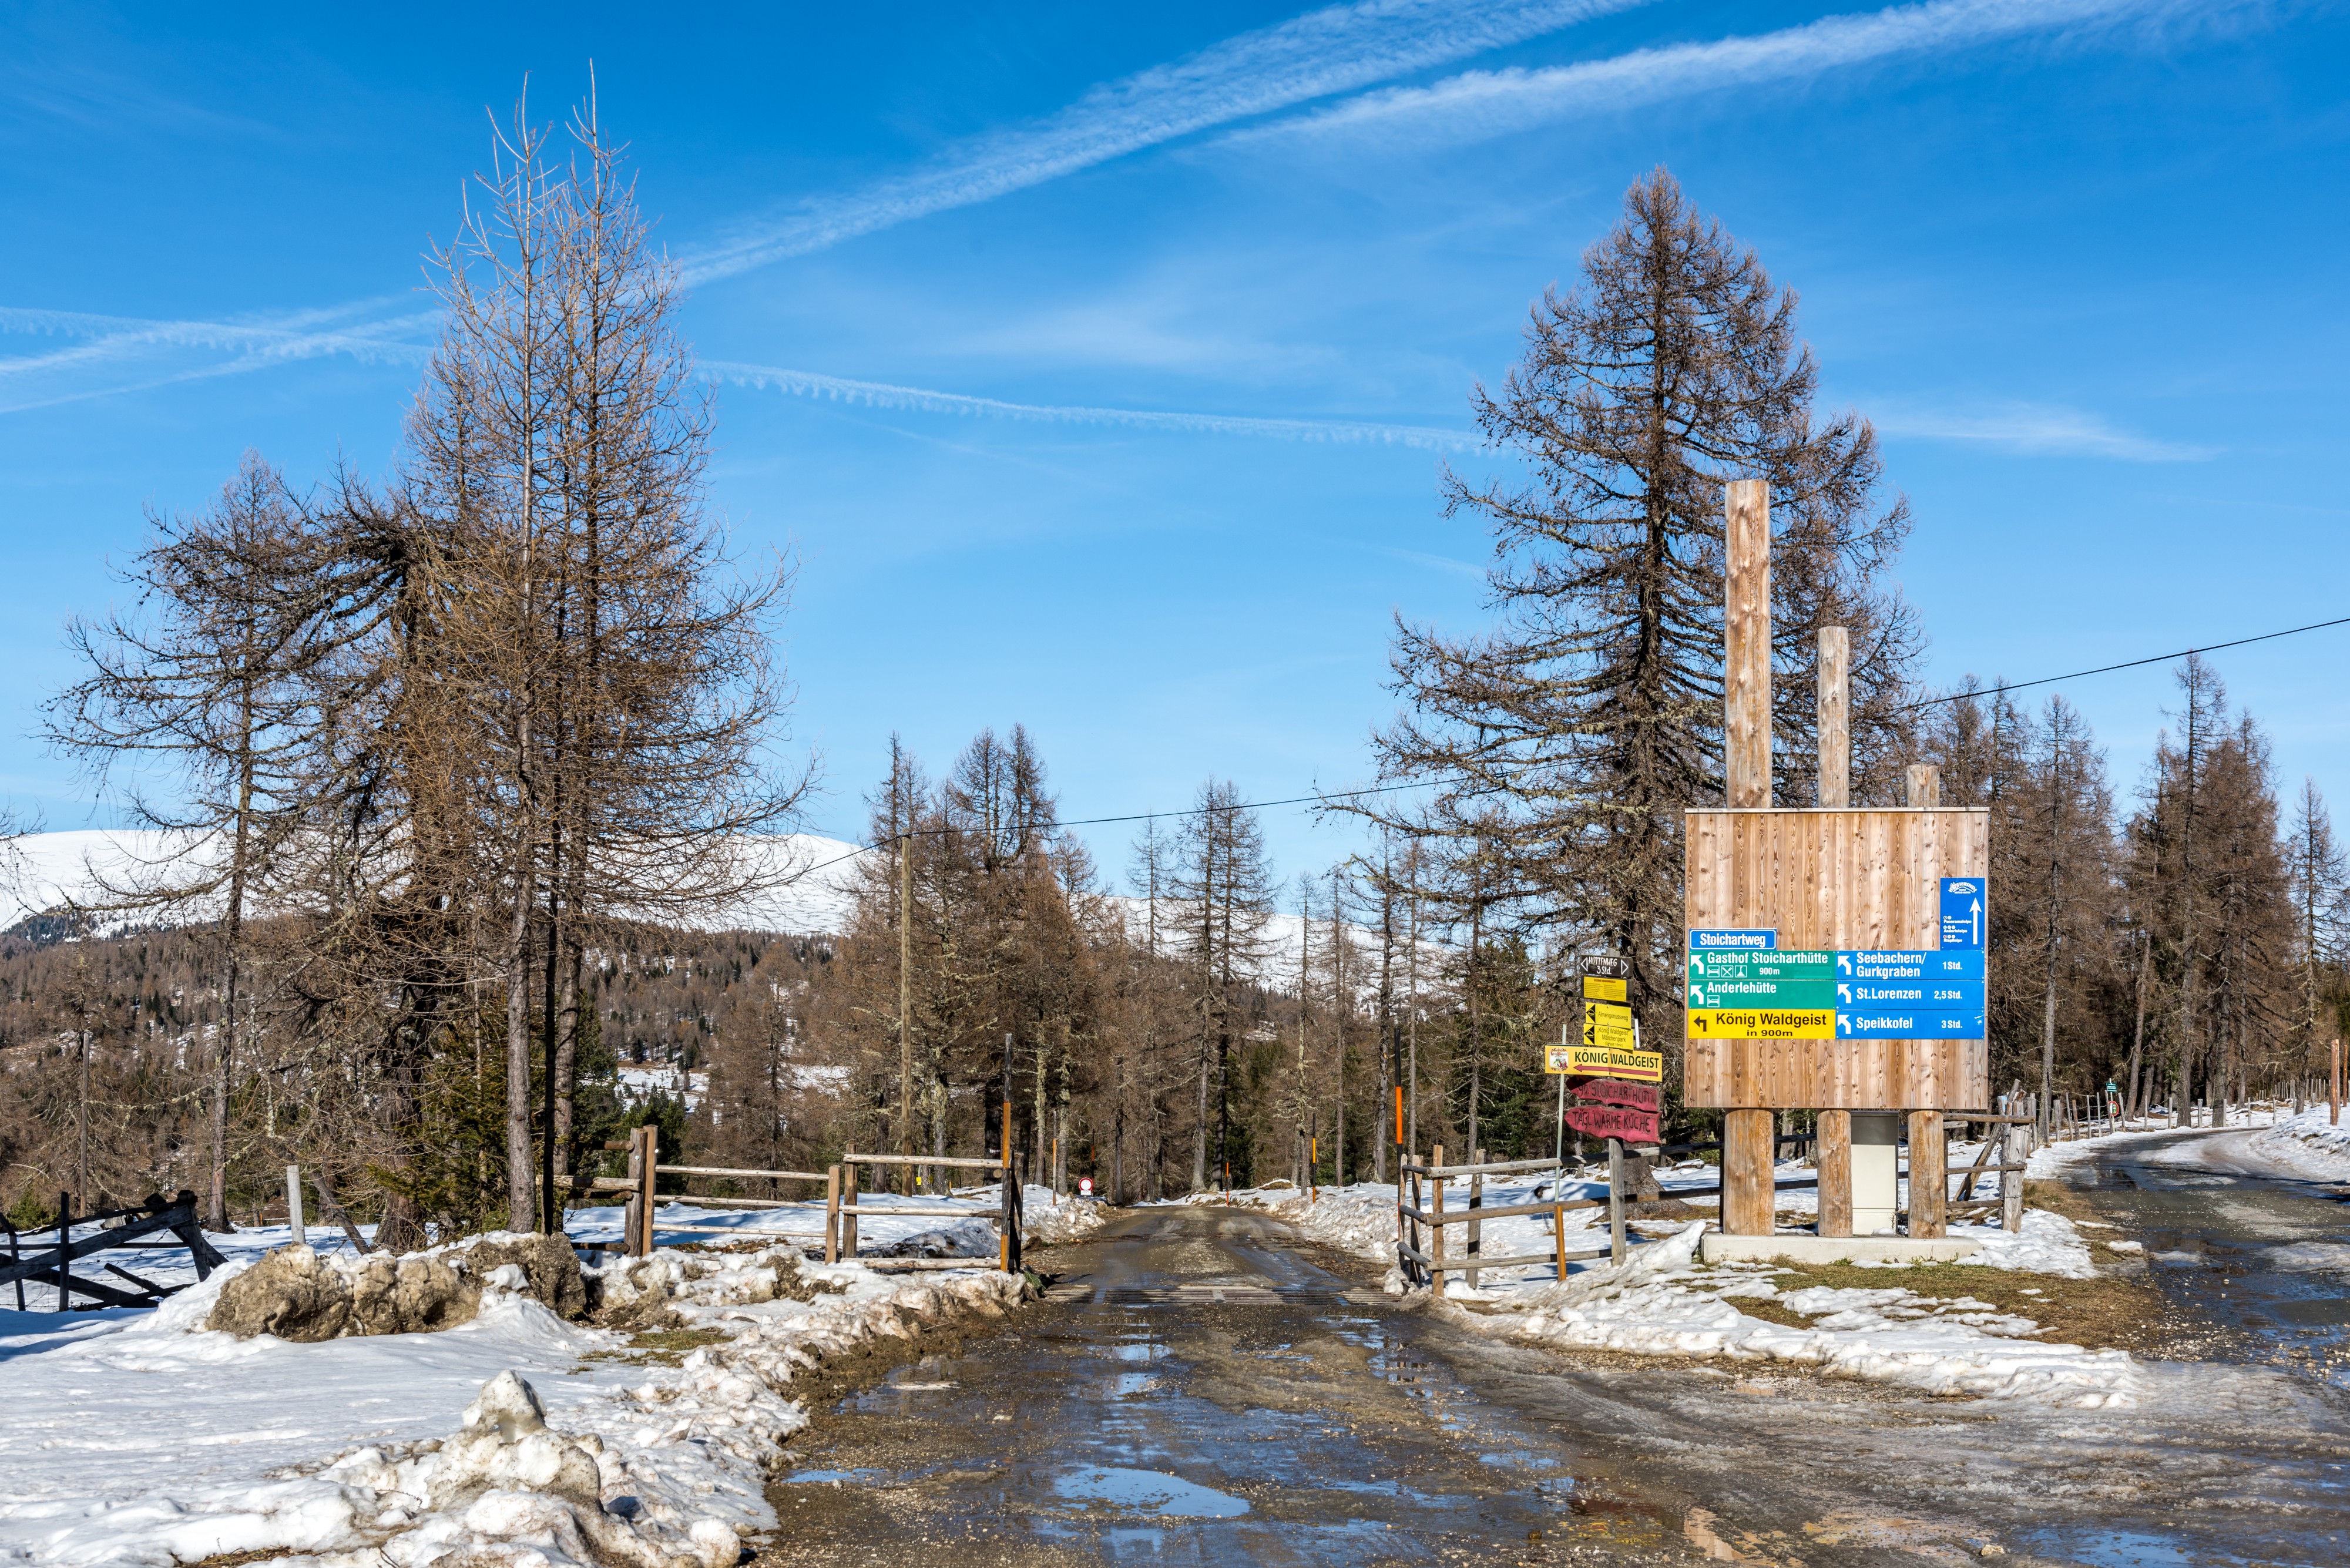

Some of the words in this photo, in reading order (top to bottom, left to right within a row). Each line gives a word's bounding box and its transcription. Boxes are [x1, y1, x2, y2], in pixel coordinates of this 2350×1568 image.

[1700, 933, 1765, 948] Stoichartweg
[1588, 956, 1617, 966] HÜTTENWEG
[1707, 952, 1748, 963] Gasthof
[1752, 952, 1828, 963] Stoicharthütte
[1856, 952, 1926, 965] Seebachern/
[1596, 966, 1601, 974] 3
[1602, 966, 1612, 975] Std.
[1856, 966, 1920, 979] Gurkgraben
[1707, 982, 1777, 993] Anderlehütte
[1934, 991, 1946, 1000] 2,5
[1948, 991, 1963, 999] Std.
[1598, 1012, 1629, 1022] Almengenussweg
[1716, 1013, 1755, 1028] König
[1760, 1013, 1827, 1028] Waldgeist
[1856, 1017, 1912, 1031] Speikkofel
[1941, 1020, 1946, 1029] 3
[1948, 1020, 1963, 1029] Std.
[1574, 1049, 1608, 1063] KÖNIG
[1610, 1053, 1659, 1069] WALDGEIST
[1623, 1113, 1651, 1133] KÜCHE
